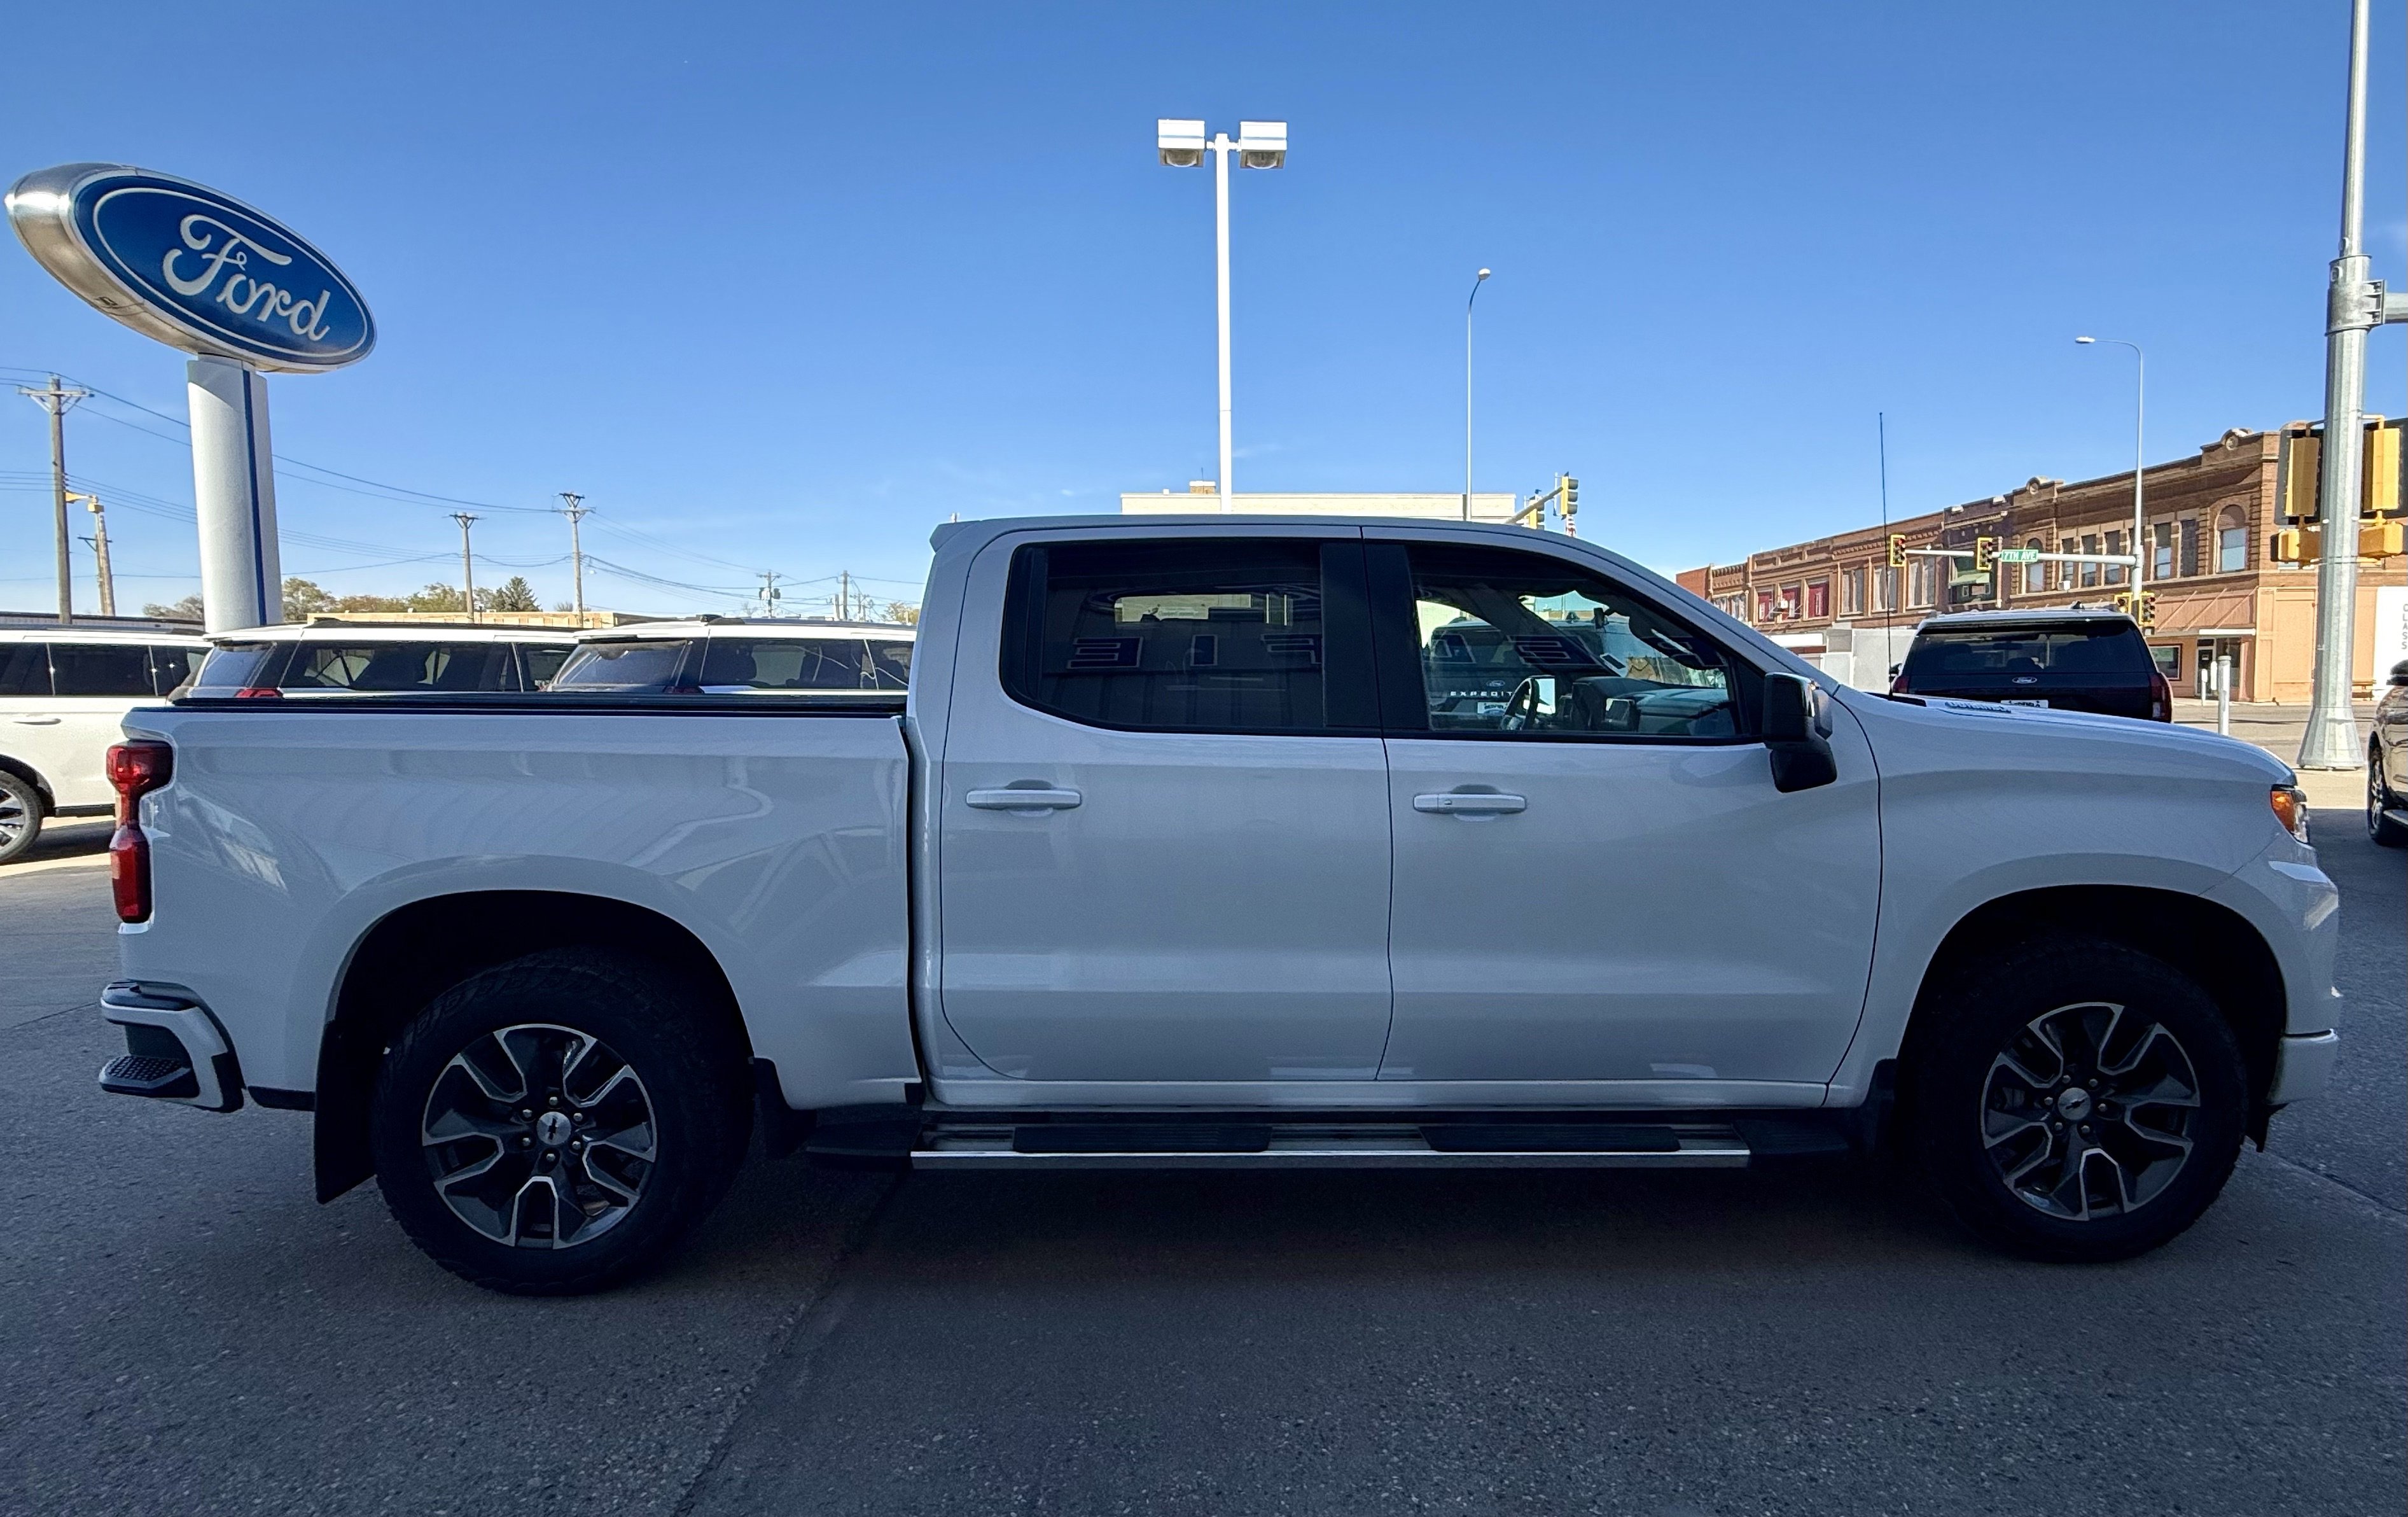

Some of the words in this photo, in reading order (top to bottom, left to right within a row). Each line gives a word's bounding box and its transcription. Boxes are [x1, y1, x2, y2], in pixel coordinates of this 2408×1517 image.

[162, 214, 331, 341] Ford
[2004, 551, 2019, 561] 7TH
[2021, 551, 2036, 561] AVE
